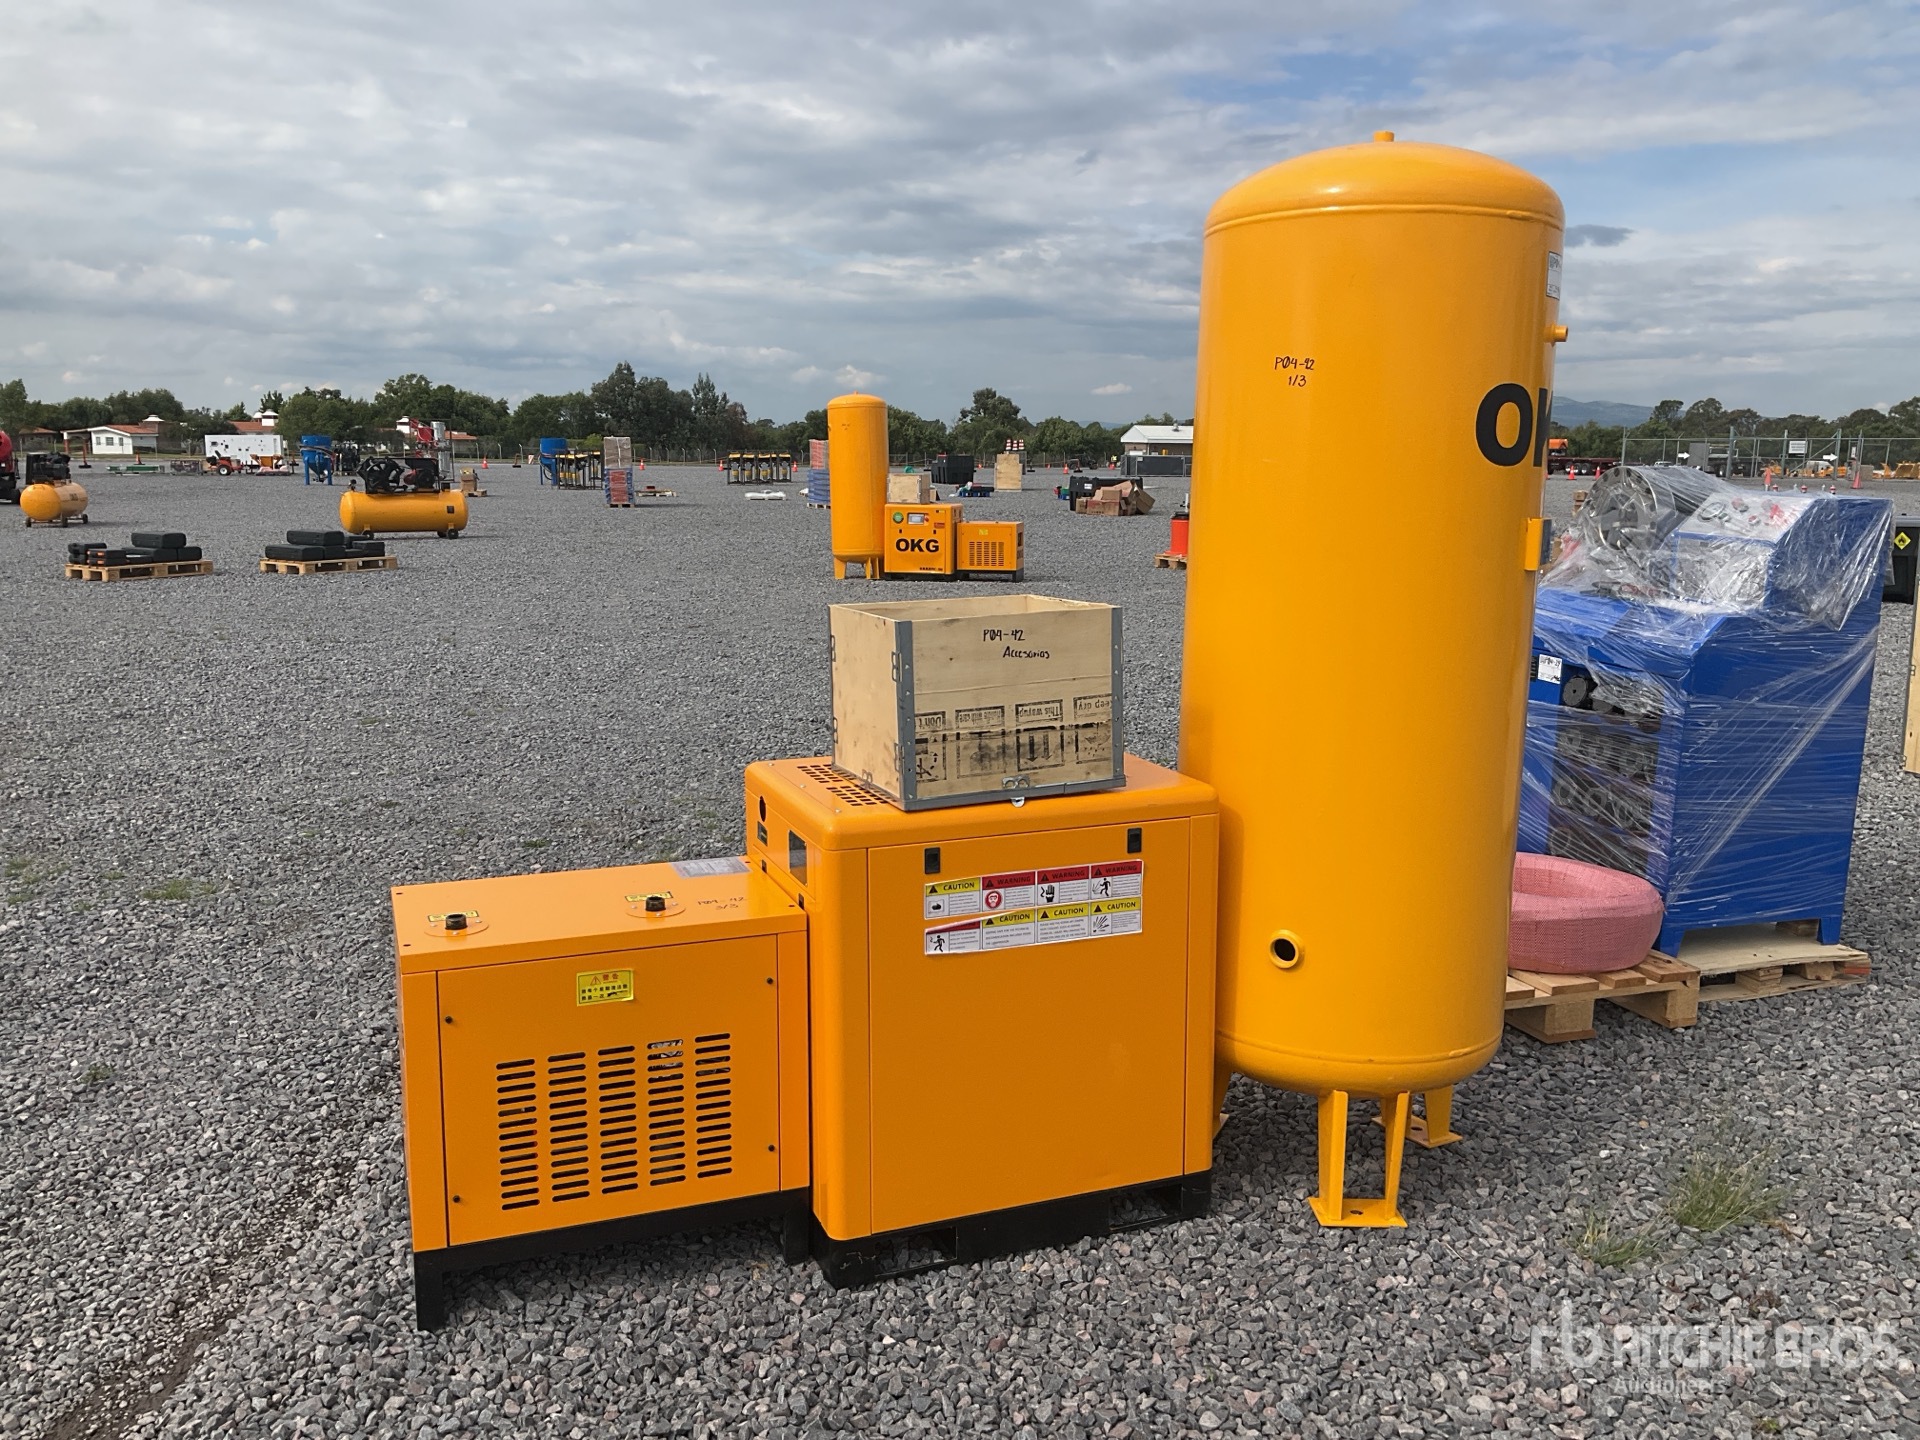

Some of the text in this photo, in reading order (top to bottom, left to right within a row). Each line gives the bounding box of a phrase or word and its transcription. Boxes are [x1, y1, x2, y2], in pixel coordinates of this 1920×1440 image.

[1288, 374, 1307, 388] 1/3
[895, 538, 940, 553] OKG
[1044, 706, 1060, 717] This
[1105, 865, 1137, 874] WARNING
[1051, 870, 1085, 879] WARNING
[997, 876, 1031, 885] WARNING
[943, 882, 975, 891] CAUTION
[1106, 901, 1136, 911] CAUTION
[1053, 907, 1084, 916] CAUTION
[999, 913, 1031, 922] CAUTION
